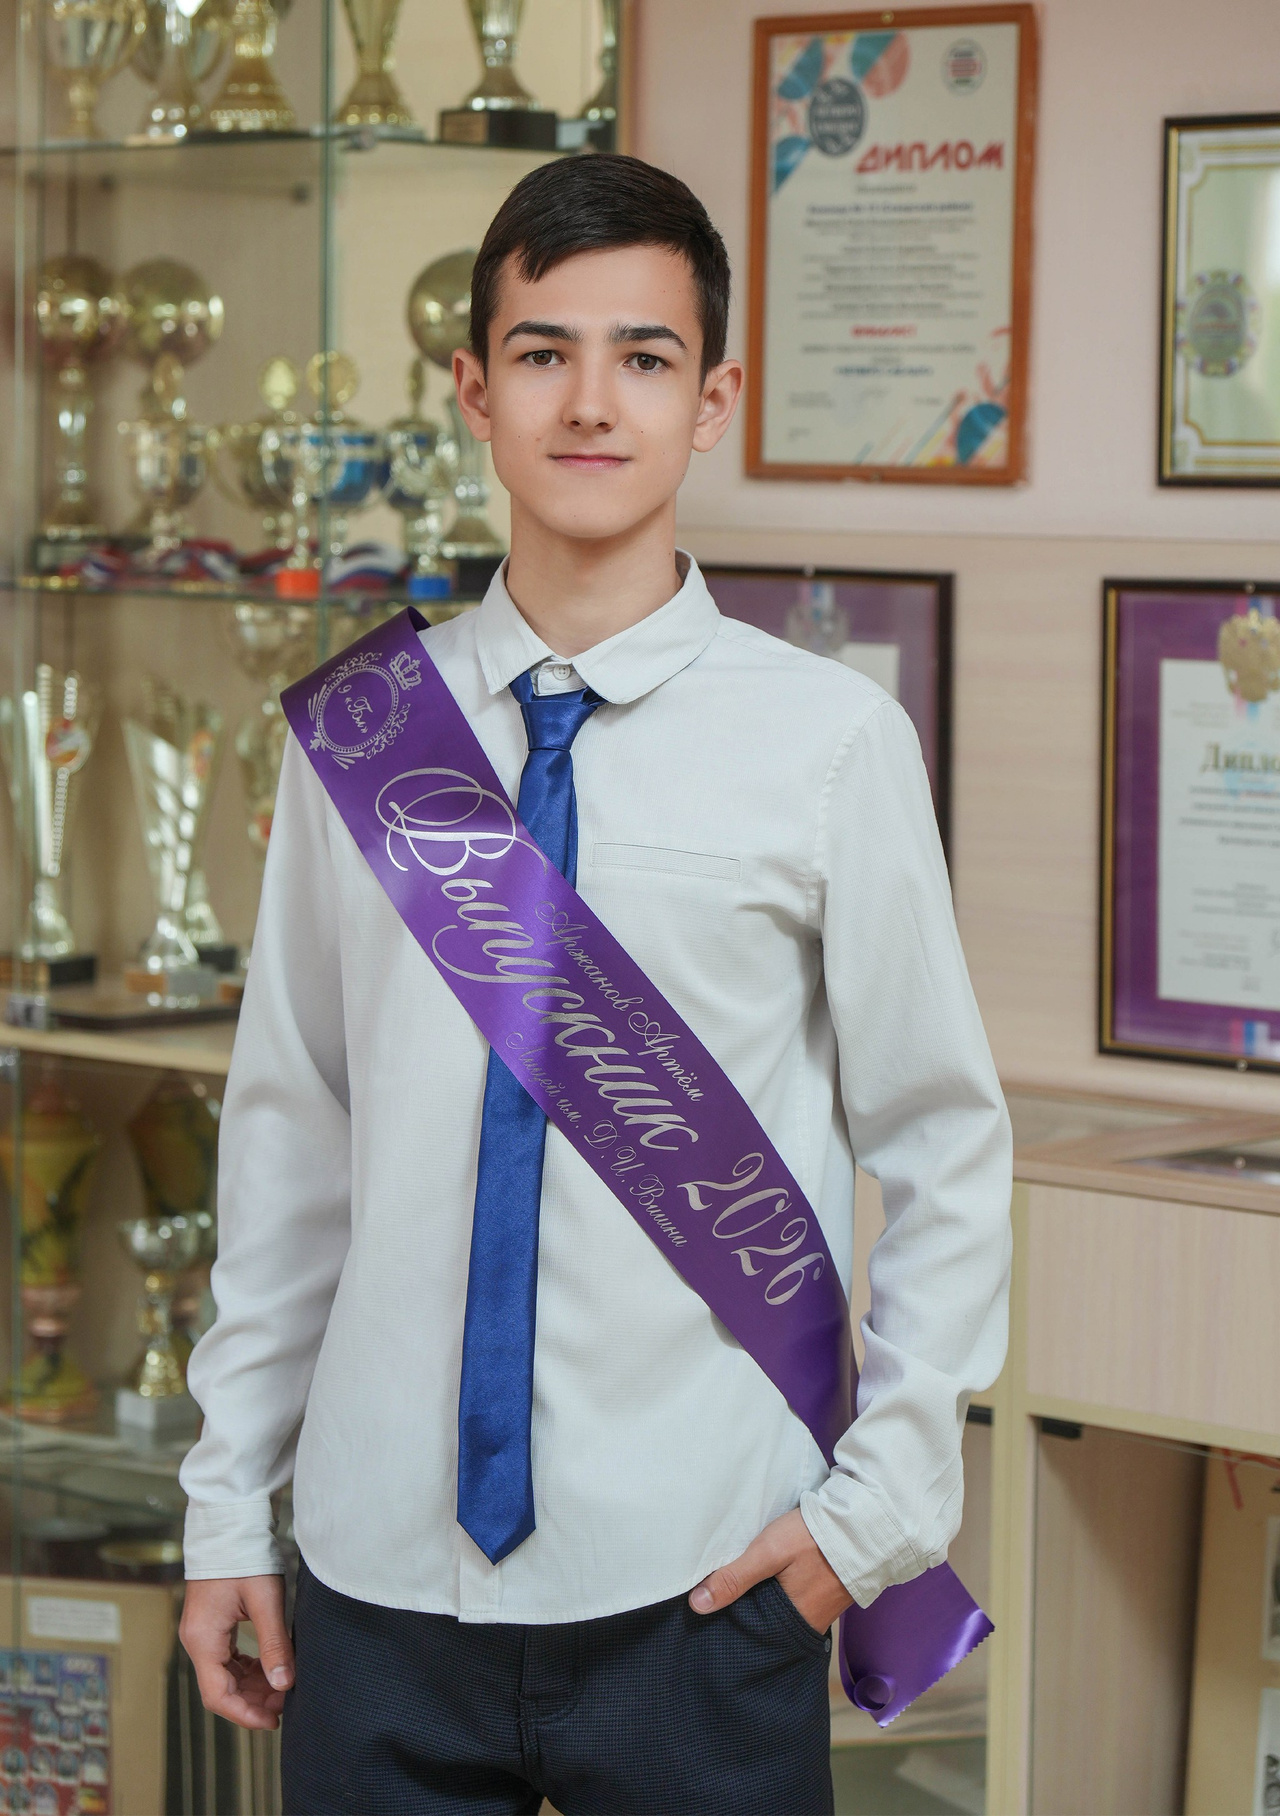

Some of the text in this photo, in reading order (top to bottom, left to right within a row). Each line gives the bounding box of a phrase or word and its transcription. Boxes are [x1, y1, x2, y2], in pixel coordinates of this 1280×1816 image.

[854, 139, 1005, 174] ДИПЛОМ
[338, 685, 352, 693] 9
[375, 767, 825, 1305] Выпускник 2026
[535, 901, 704, 1101] Аржанов Артём
[505, 1032, 566, 1098] Лицей
[557, 1099, 582, 1129] им.
[630, 1174, 689, 1248] Вишни
